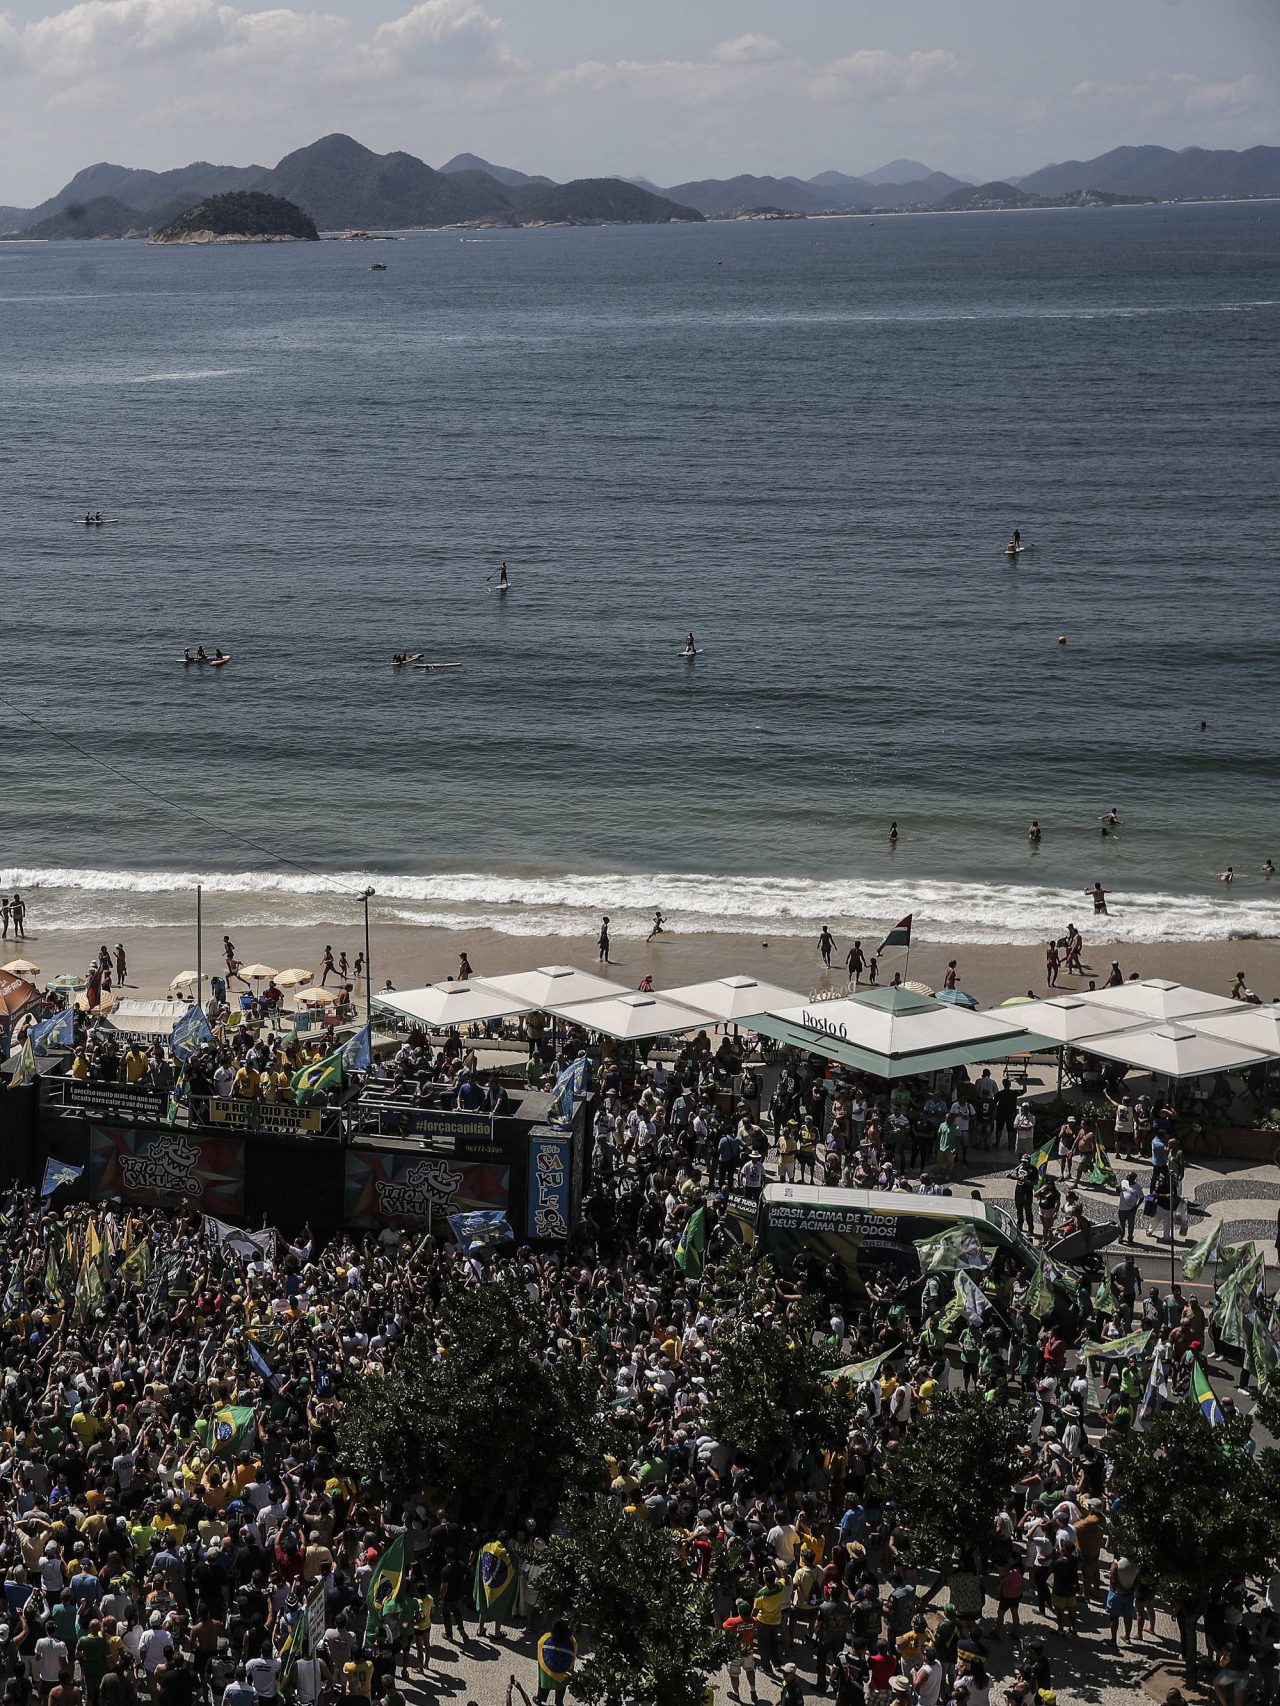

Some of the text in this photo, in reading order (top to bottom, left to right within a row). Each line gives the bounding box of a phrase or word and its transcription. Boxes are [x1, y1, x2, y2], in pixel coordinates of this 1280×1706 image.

[839, 1022, 848, 1039] 6
[71, 1094, 91, 1102] facada
[91, 1095, 105, 1104] para
[106, 1096, 121, 1106] calar
[126, 1100, 136, 1108] voz
[75, 1088, 95, 1097] preciso
[96, 1089, 113, 1098] muito
[114, 1091, 128, 1100] mais
[129, 1093, 137, 1101] do
[216, 1102, 312, 1120] EU REDIO ESSE
[982, 1103, 990, 1113] 9
[224, 1112, 246, 1123] ATO
[416, 1120, 491, 1135] #forçacapitão
[127, 1160, 157, 1175] TRIO
[383, 1186, 416, 1201] TRIO
[770, 1207, 805, 1219] BRASIL
[807, 1211, 843, 1222] ACIMA
[863, 1215, 898, 1226] TUDO!
[770, 1218, 897, 1237] DEUS ACIMA DE TODOS!
[862, 1240, 897, 1248] ORDEM
[320, 1375, 331, 1387] 10
